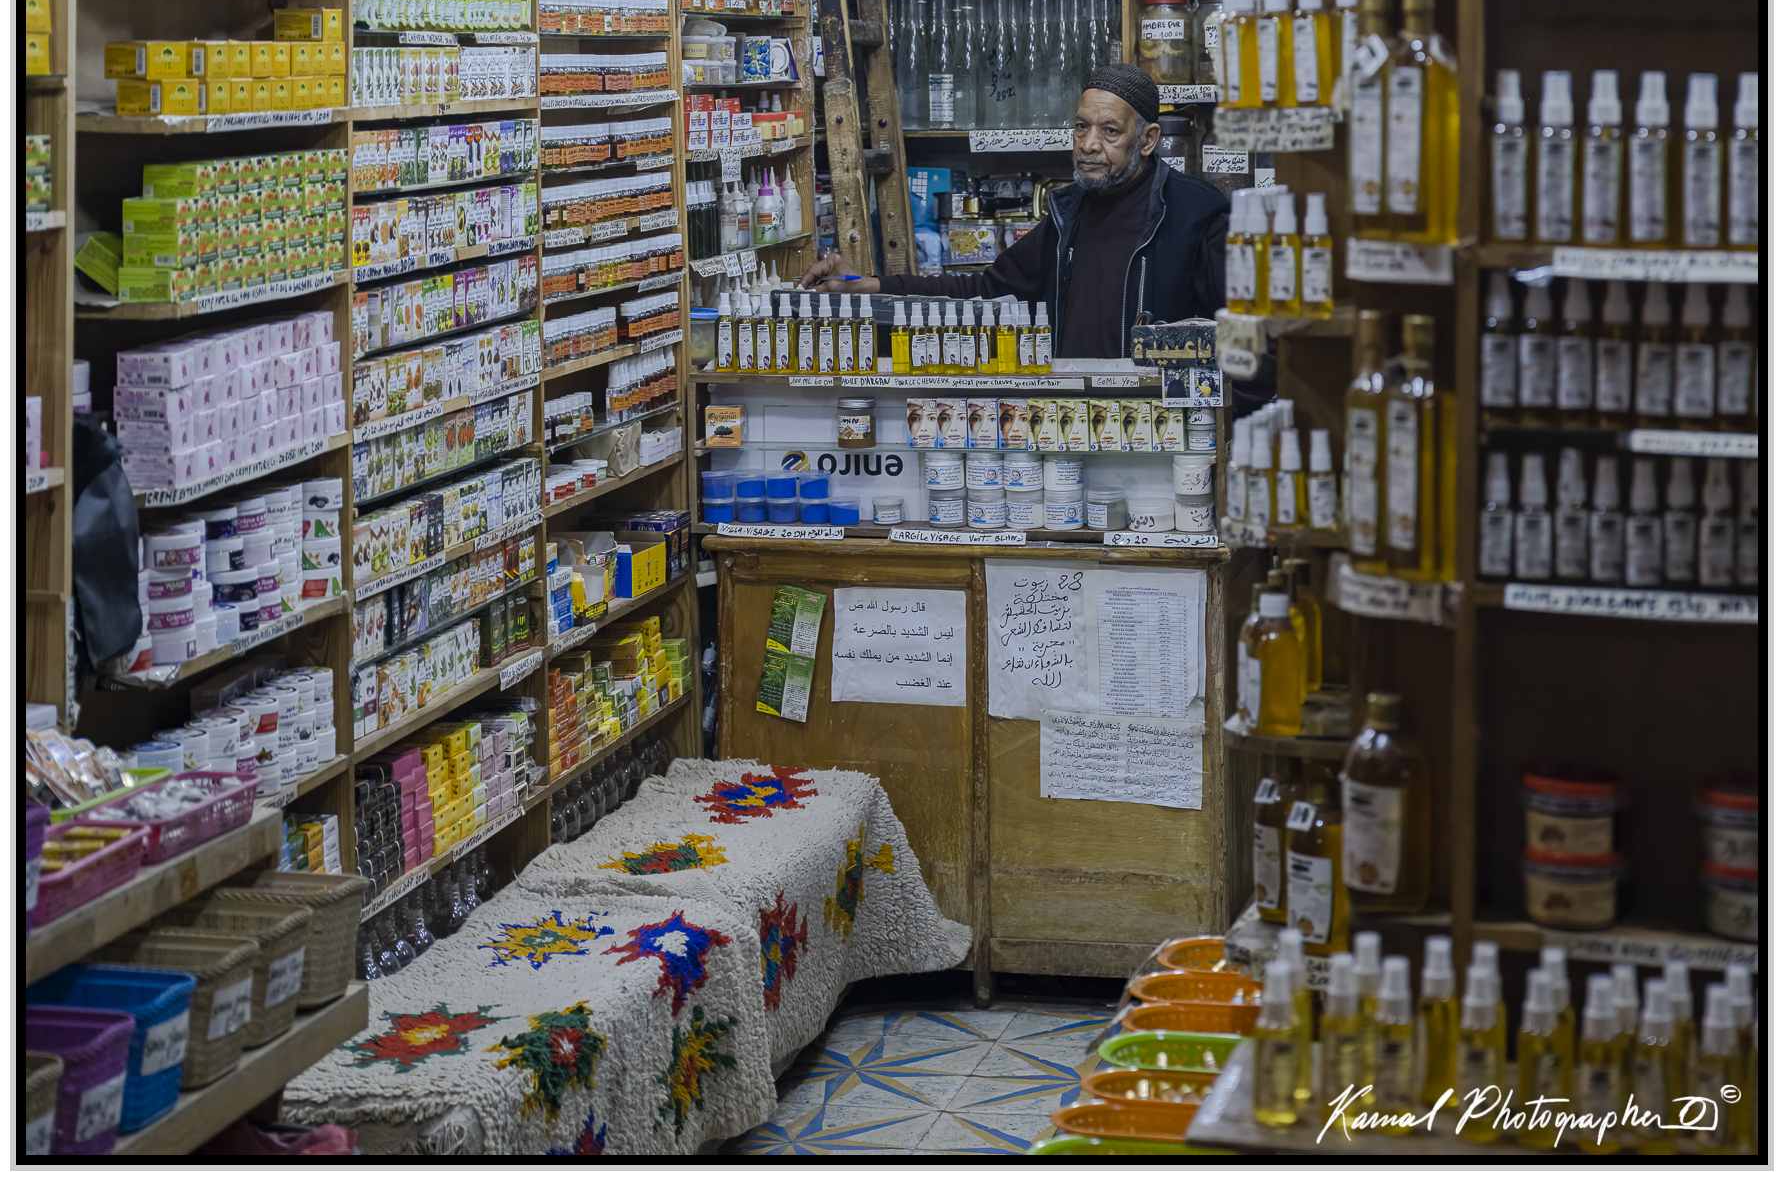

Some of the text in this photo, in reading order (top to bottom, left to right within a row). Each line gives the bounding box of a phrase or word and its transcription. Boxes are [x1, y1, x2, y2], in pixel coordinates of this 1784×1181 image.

[1142, 20, 1167, 30] AMBRE
[781, 529, 791, 537] 20
[1135, 536, 1148, 544] 20
[1013, 572, 1083, 592] 28 زيوت
[867, 600, 926, 613] قال رسول الله
[901, 626, 954, 640] ليس الشديد
[834, 648, 953, 667] إنما الشديد من يملك نفسه
[896, 677, 953, 689] عند الغضب
[1031, 672, 1062, 688] الله
